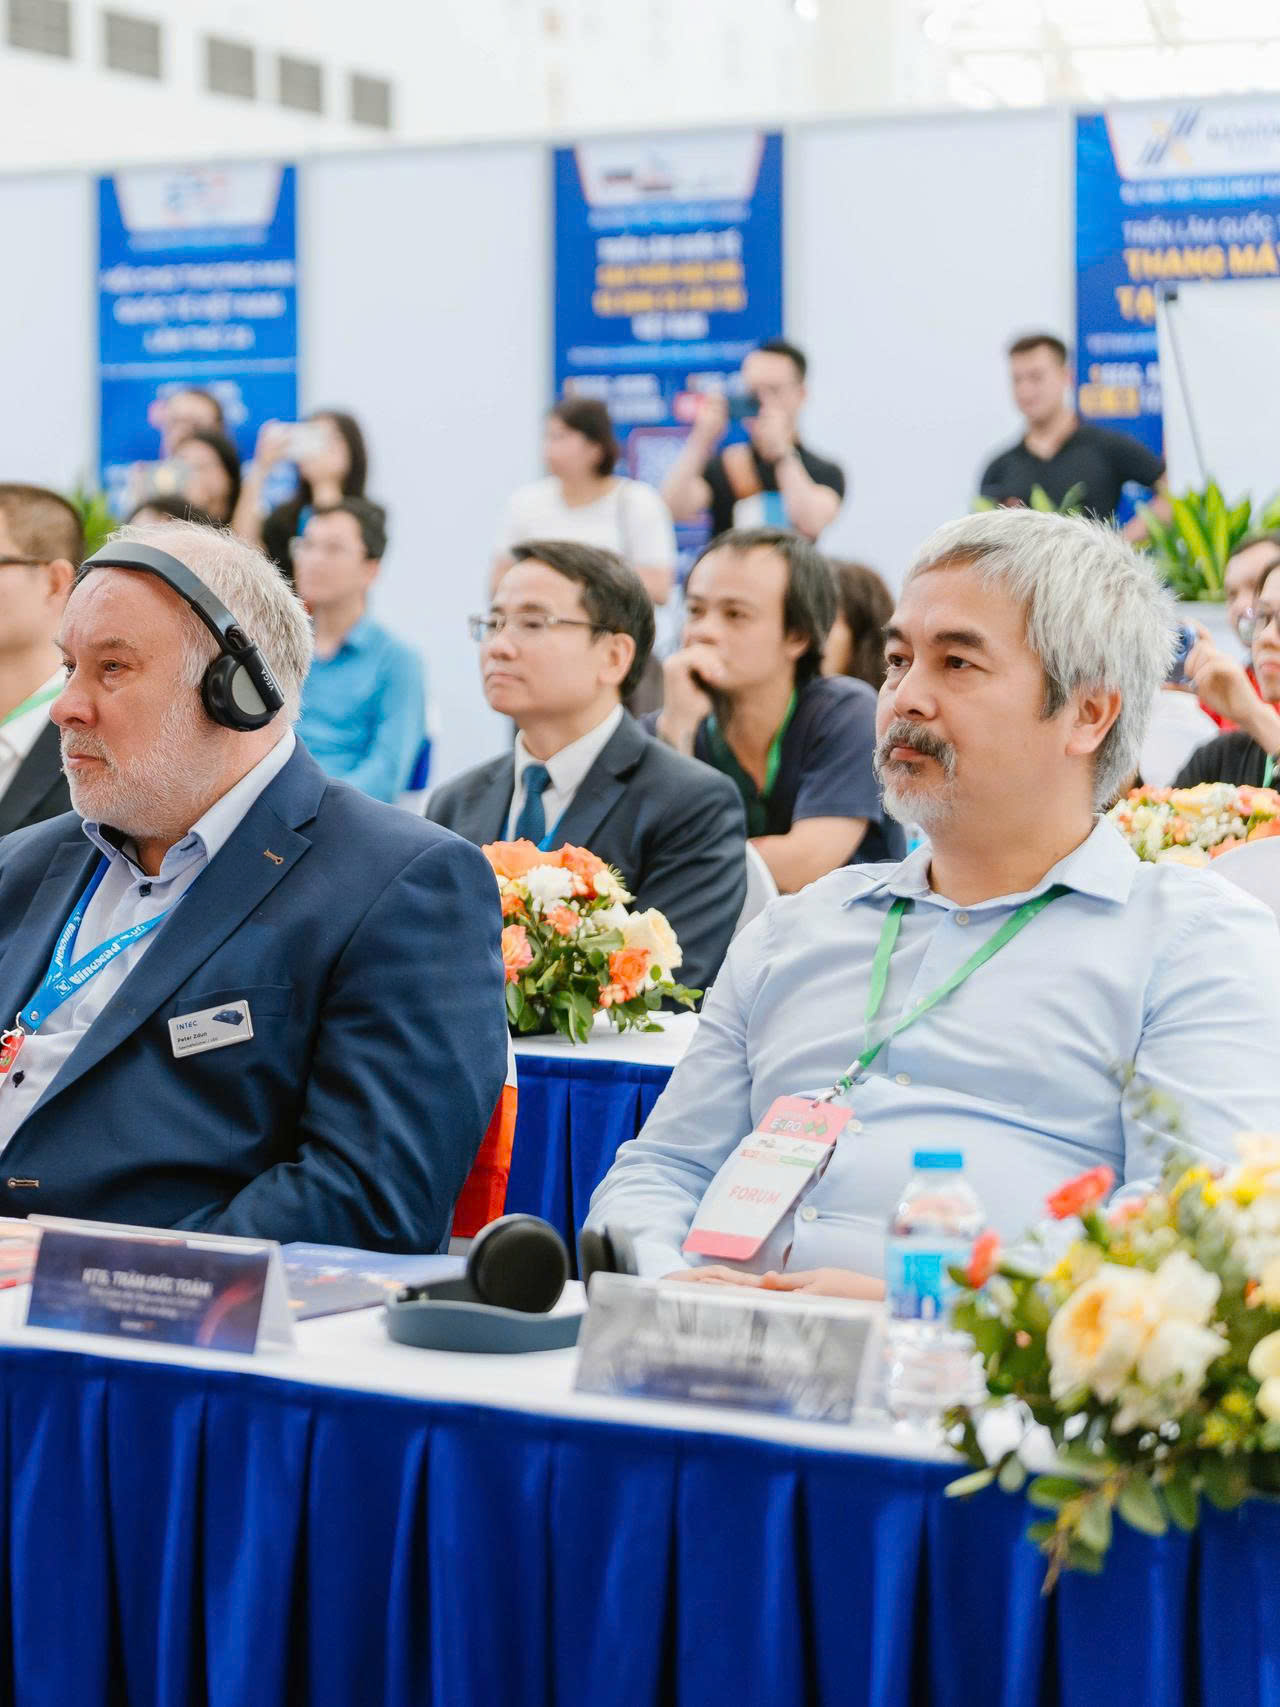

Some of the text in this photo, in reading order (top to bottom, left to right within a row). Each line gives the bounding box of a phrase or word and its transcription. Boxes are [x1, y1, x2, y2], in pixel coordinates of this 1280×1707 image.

[260, 668, 274, 691] VEGA
[175, 1020, 198, 1031] INTEC
[728, 1185, 783, 1205] FORUM
